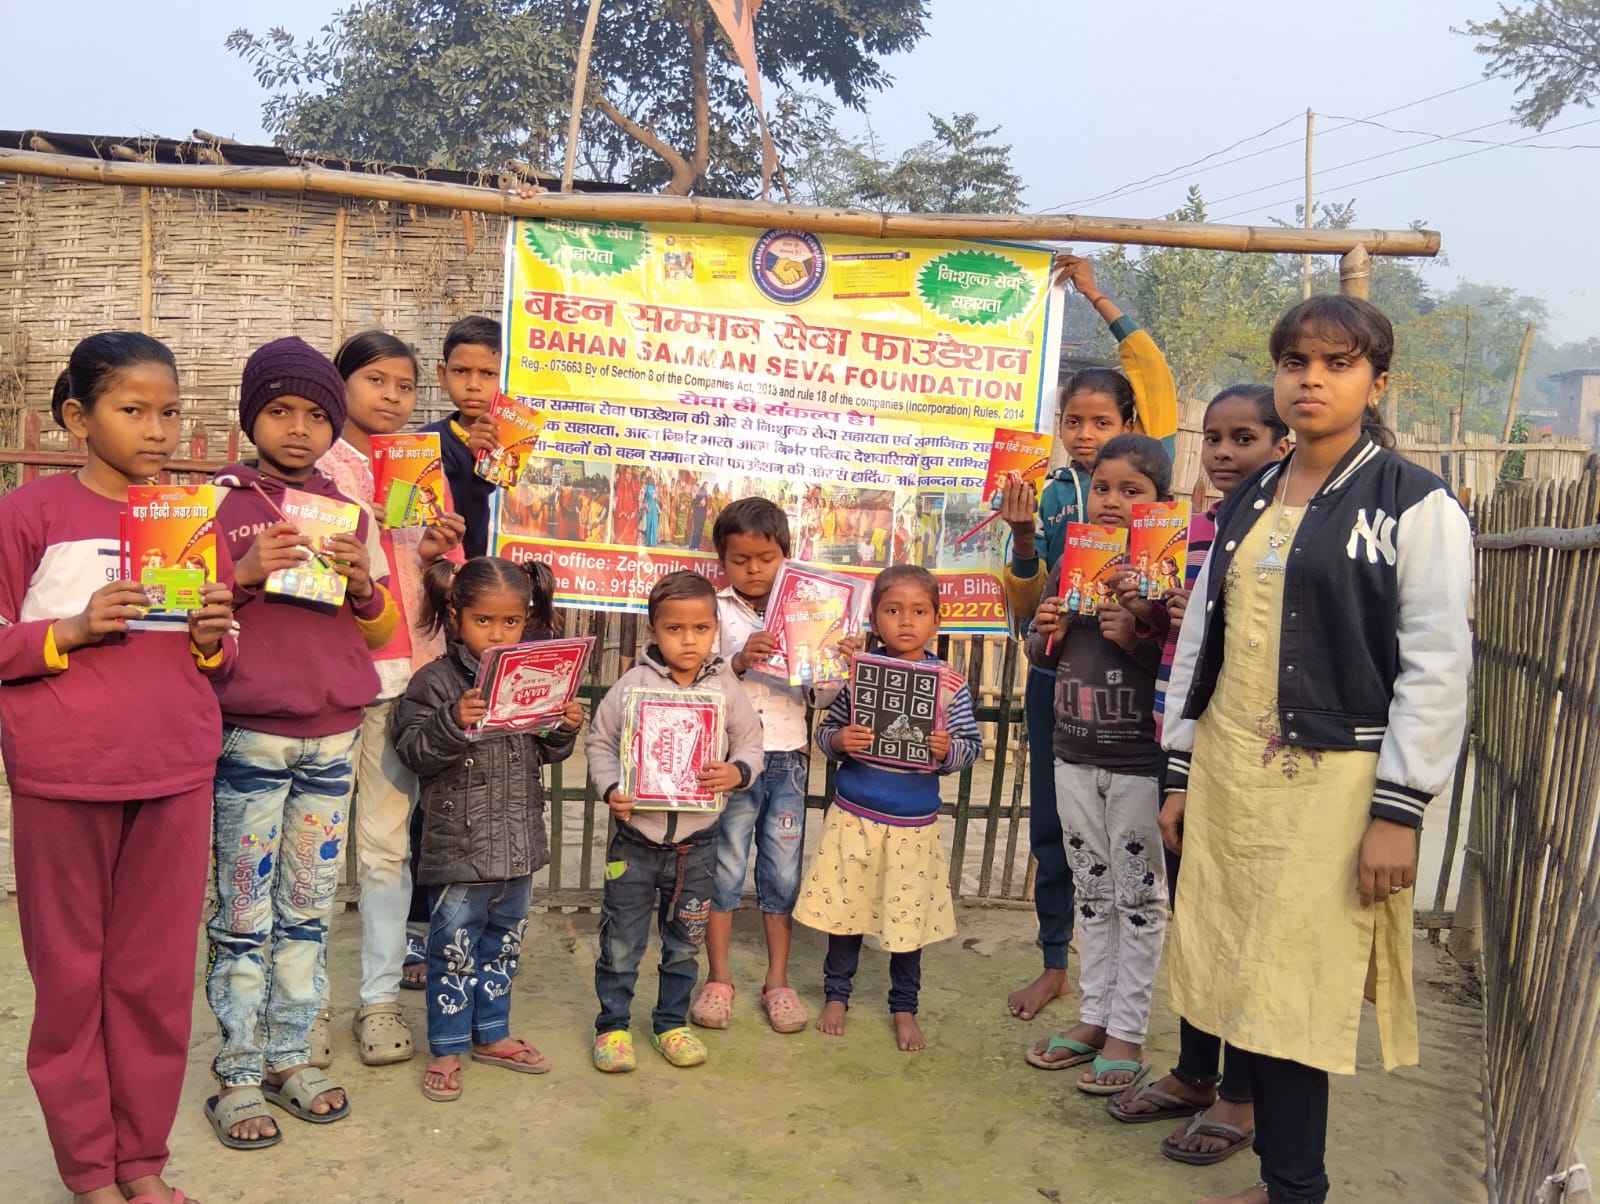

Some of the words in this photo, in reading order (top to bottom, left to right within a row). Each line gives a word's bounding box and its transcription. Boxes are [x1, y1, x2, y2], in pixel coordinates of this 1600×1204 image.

[606, 221, 634, 240] सेवा
[561, 244, 614, 264] हायता
[938, 264, 992, 288] निःशुल्क
[994, 272, 1023, 291] सेवा
[951, 295, 1002, 314] सहायता
[524, 290, 617, 327] बहन
[627, 302, 764, 345] सम्मान
[774, 314, 852, 356] सेवा
[529, 328, 626, 359] BAHAN
[637, 340, 756, 375] SAMMAN
[766, 354, 835, 386] SEVA
[844, 366, 1023, 402] FOUNDATION
[550, 359, 582, 374] 075663
[585, 363, 597, 378] By
[599, 364, 609, 376] of
[611, 365, 646, 381] Section
[648, 369, 654, 382] 8
[656, 371, 665, 382] of
[667, 371, 683, 385] the
[684, 374, 734, 391] Companies
[736, 380, 754, 394] Act,
[757, 383, 778, 397] 2013
[779, 386, 795, 399] and
[797, 388, 814, 401] rule
[817, 391, 827, 402] 18
[829, 392, 839, 404] of
[840, 393, 854, 405] the
[855, 397, 904, 412] companies
[905, 400, 971, 418] (Incorporation)
[973, 405, 1001, 419] Rules,
[1003, 408, 1025, 420] 2014
[678, 390, 727, 408] सेवा
[733, 396, 759, 413] ही
[763, 402, 841, 423] संकल्प
[550, 399, 595, 414] सम्मान
[600, 401, 626, 416] सेवा
[692, 411, 710, 426] की
[713, 414, 737, 428] ओर
[740, 417, 753, 431] से
[757, 419, 808, 439] निःशुल्क
[841, 430, 889, 445] सहायता
[892, 434, 913, 446] एवं
[543, 420, 561, 431] क
[564, 420, 620, 438] सहायता,
[663, 428, 698, 445] निर्भर
[701, 434, 734, 449] भारत
[775, 440, 808, 457] निर्भर
[810, 445, 851, 461] परिवार
[854, 449, 920, 467] देशवासियों
[921, 456, 944, 470] युवा
[594, 443, 612, 457] को
[616, 446, 645, 460] बहन
[650, 450, 695, 465] सम्मान
[698, 452, 724, 467] सेवा
[787, 462, 805, 476] की
[850, 469, 892, 484] हार्दिक
[961, 476, 986, 488] कर
[132, 505, 148, 522] बड़ा
[150, 502, 170, 519] हिन्दी
[193, 503, 209, 518] बोध
[1346, 508, 1397, 566] NY
[512, 547, 553, 564] Head
[558, 551, 611, 570] office:
[575, 576, 605, 592] No.:
[939, 582, 958, 597] ur,
[863, 668, 873, 681] 1
[890, 674, 902, 687] 2
[919, 678, 931, 691] 3
[861, 691, 873, 703] 4
[888, 696, 900, 709] 5
[916, 702, 929, 715] 6
[1053, 679, 1141, 723] HILL
[858, 713, 871, 726] 7
[884, 743, 897, 754] 9
[910, 746, 927, 760] 10
